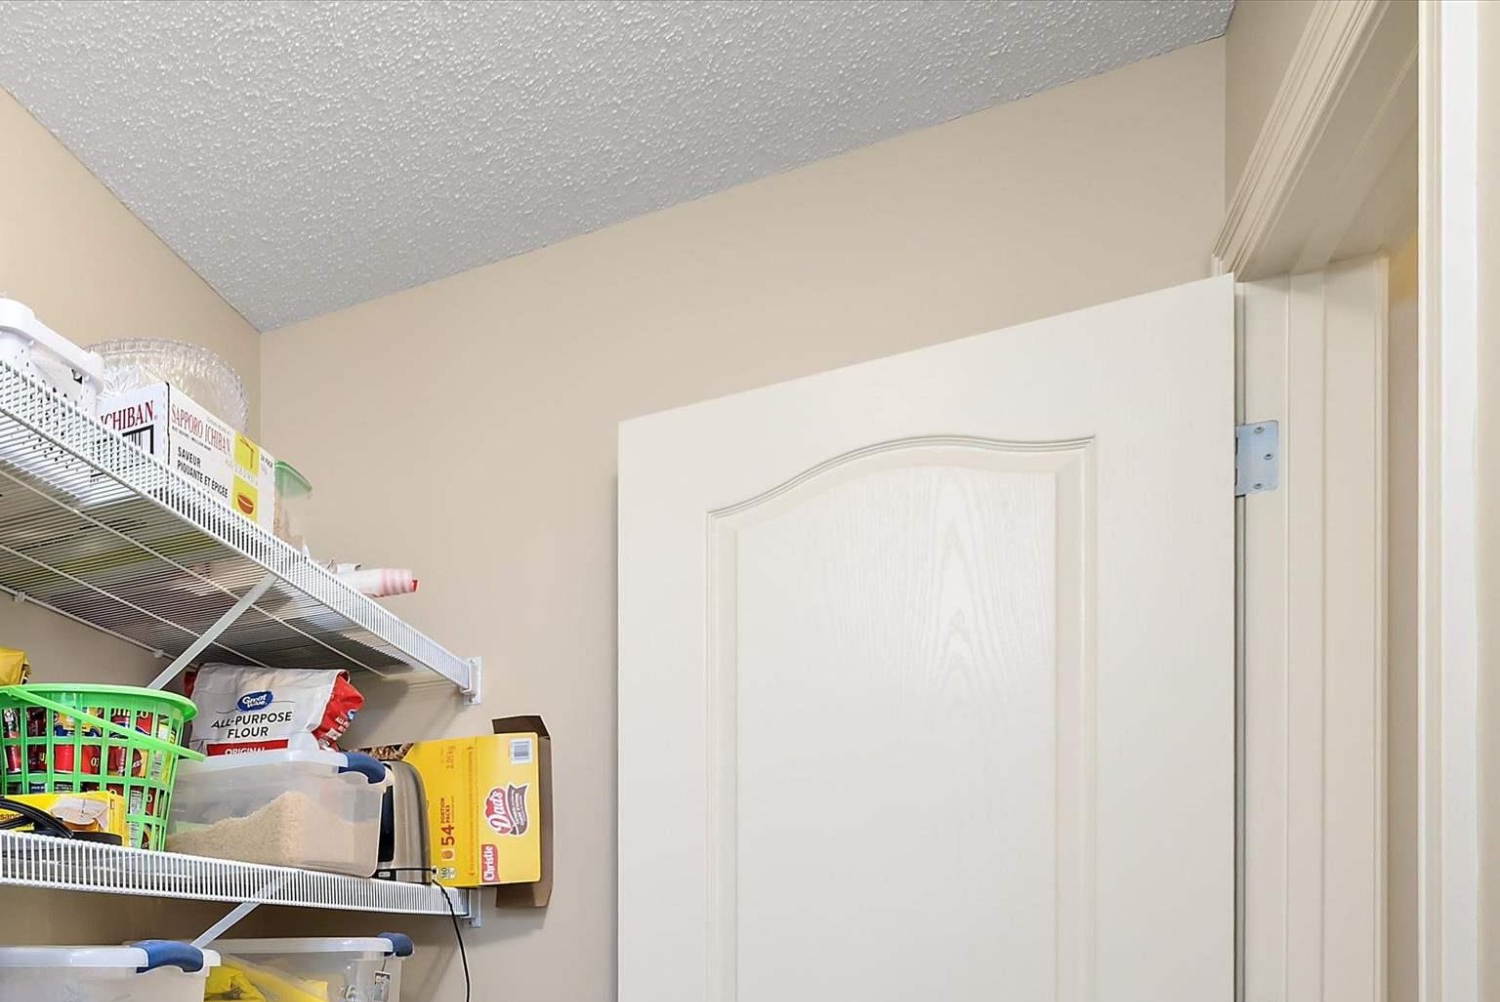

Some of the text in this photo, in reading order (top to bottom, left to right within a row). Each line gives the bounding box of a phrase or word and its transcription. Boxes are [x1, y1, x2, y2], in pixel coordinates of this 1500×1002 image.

[205, 424, 231, 455] ICHIBAN
[177, 446, 202, 468] SAVEUR
[242, 695, 267, 706] Great
[211, 712, 293, 729] ALL-PURPOSE
[227, 726, 269, 739] FLOUR
[489, 789, 512, 834] Dad's
[440, 824, 455, 847] 54
[483, 845, 495, 882] Christie
